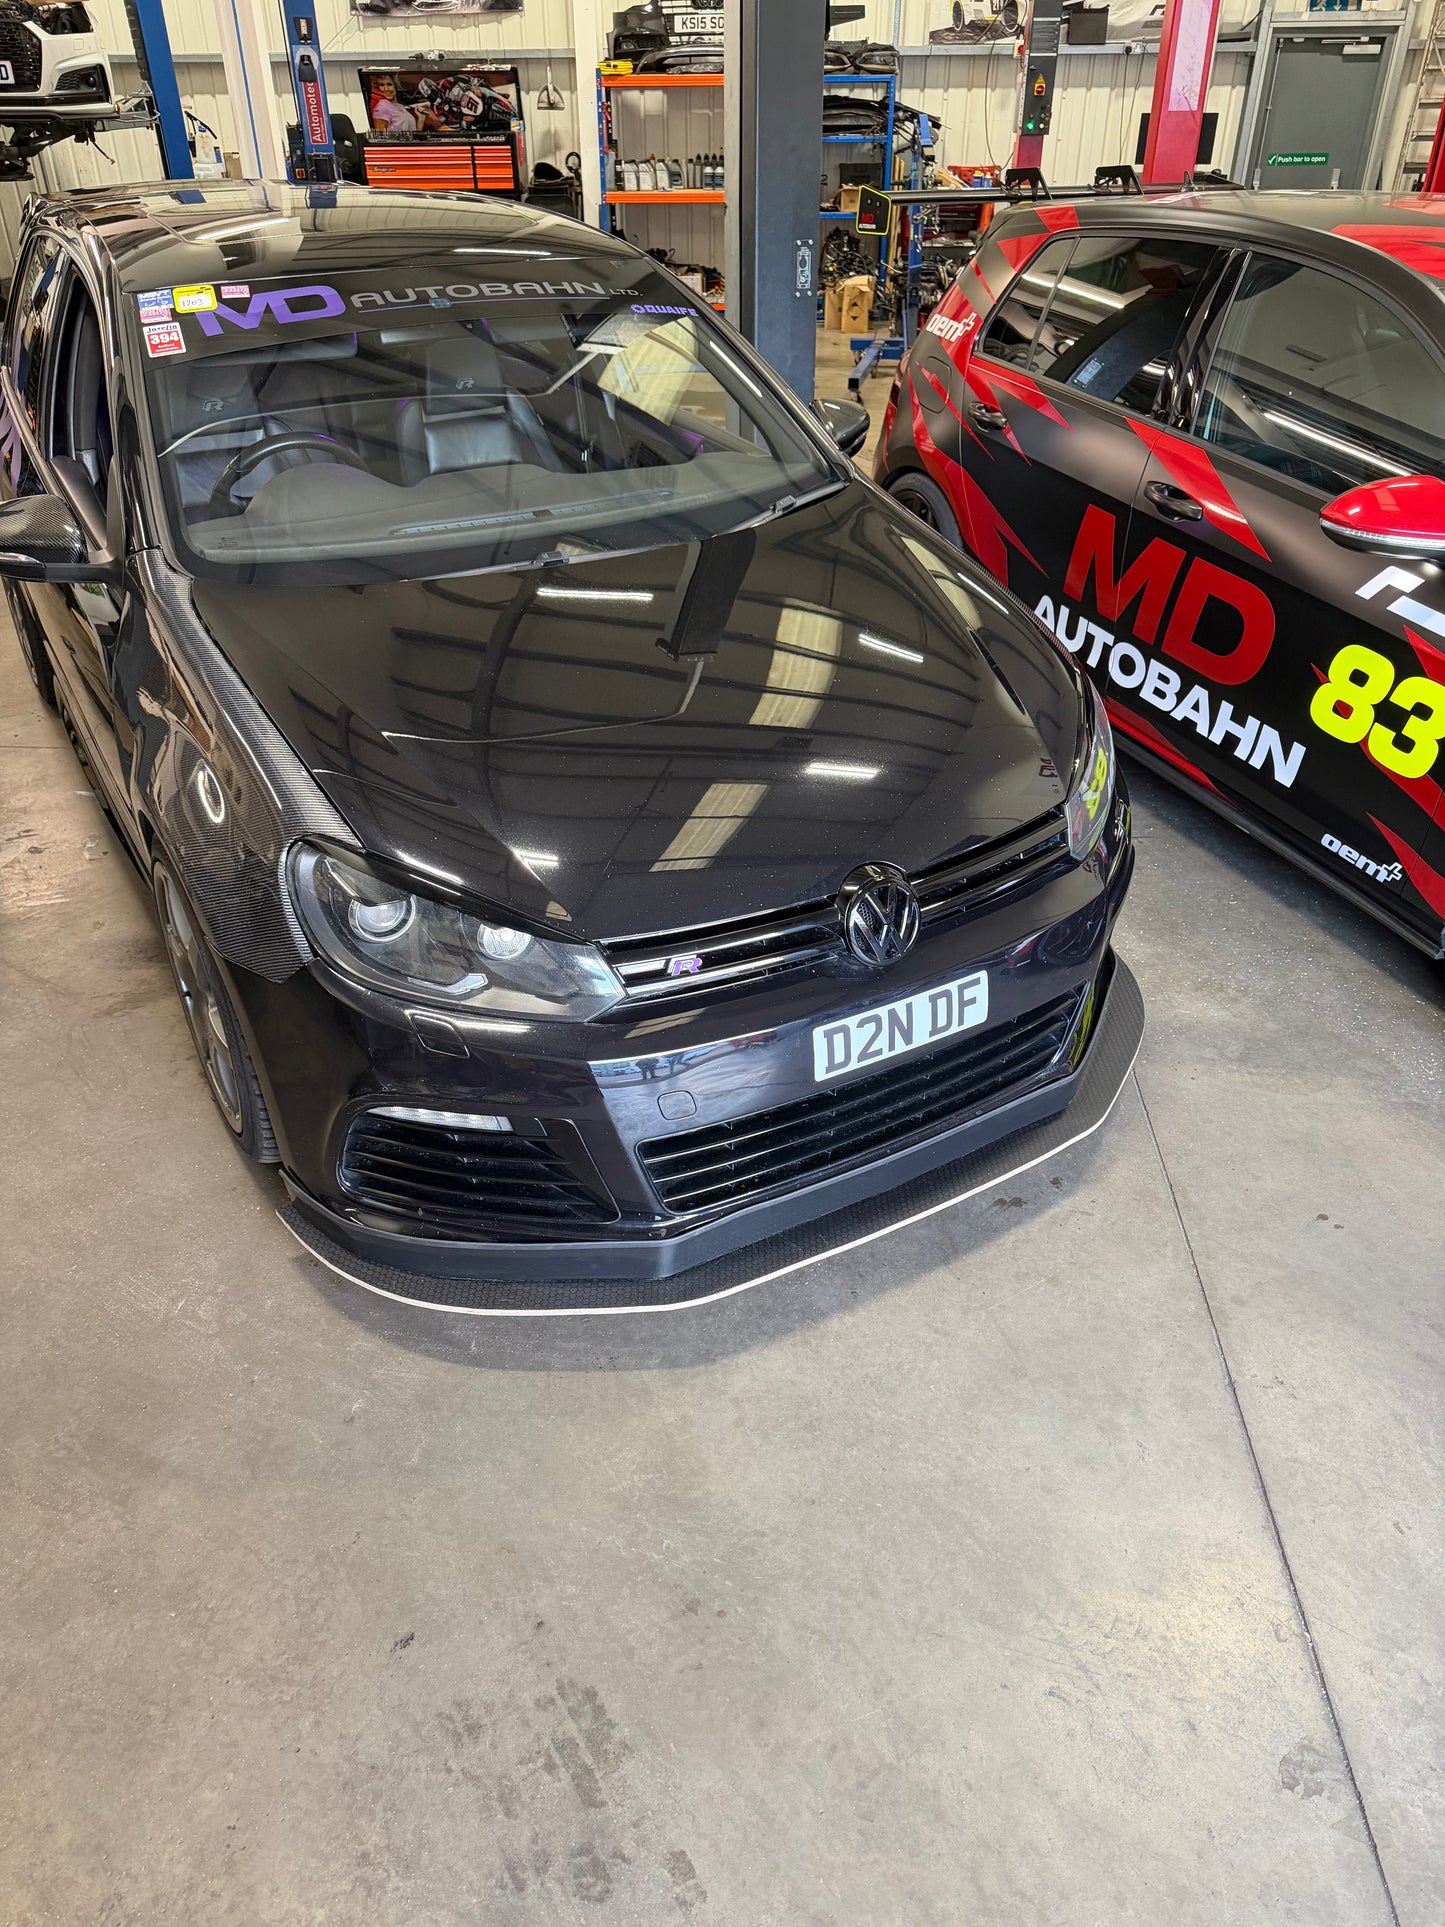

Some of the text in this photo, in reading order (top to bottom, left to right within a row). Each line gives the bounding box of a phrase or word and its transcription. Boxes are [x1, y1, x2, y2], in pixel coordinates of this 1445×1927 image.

[681, 17, 706, 29] KS15
[350, 282, 606, 308] AUTOBAHN
[643, 304, 700, 317] QUAIFE
[146, 324, 178, 334] Javelin
[149, 332, 179, 345] 394
[1063, 504, 1276, 686] MD
[1034, 595, 1307, 789] AUTOBAHN
[1310, 644, 1445, 779] 83
[823, 977, 981, 1074] D2N DF
